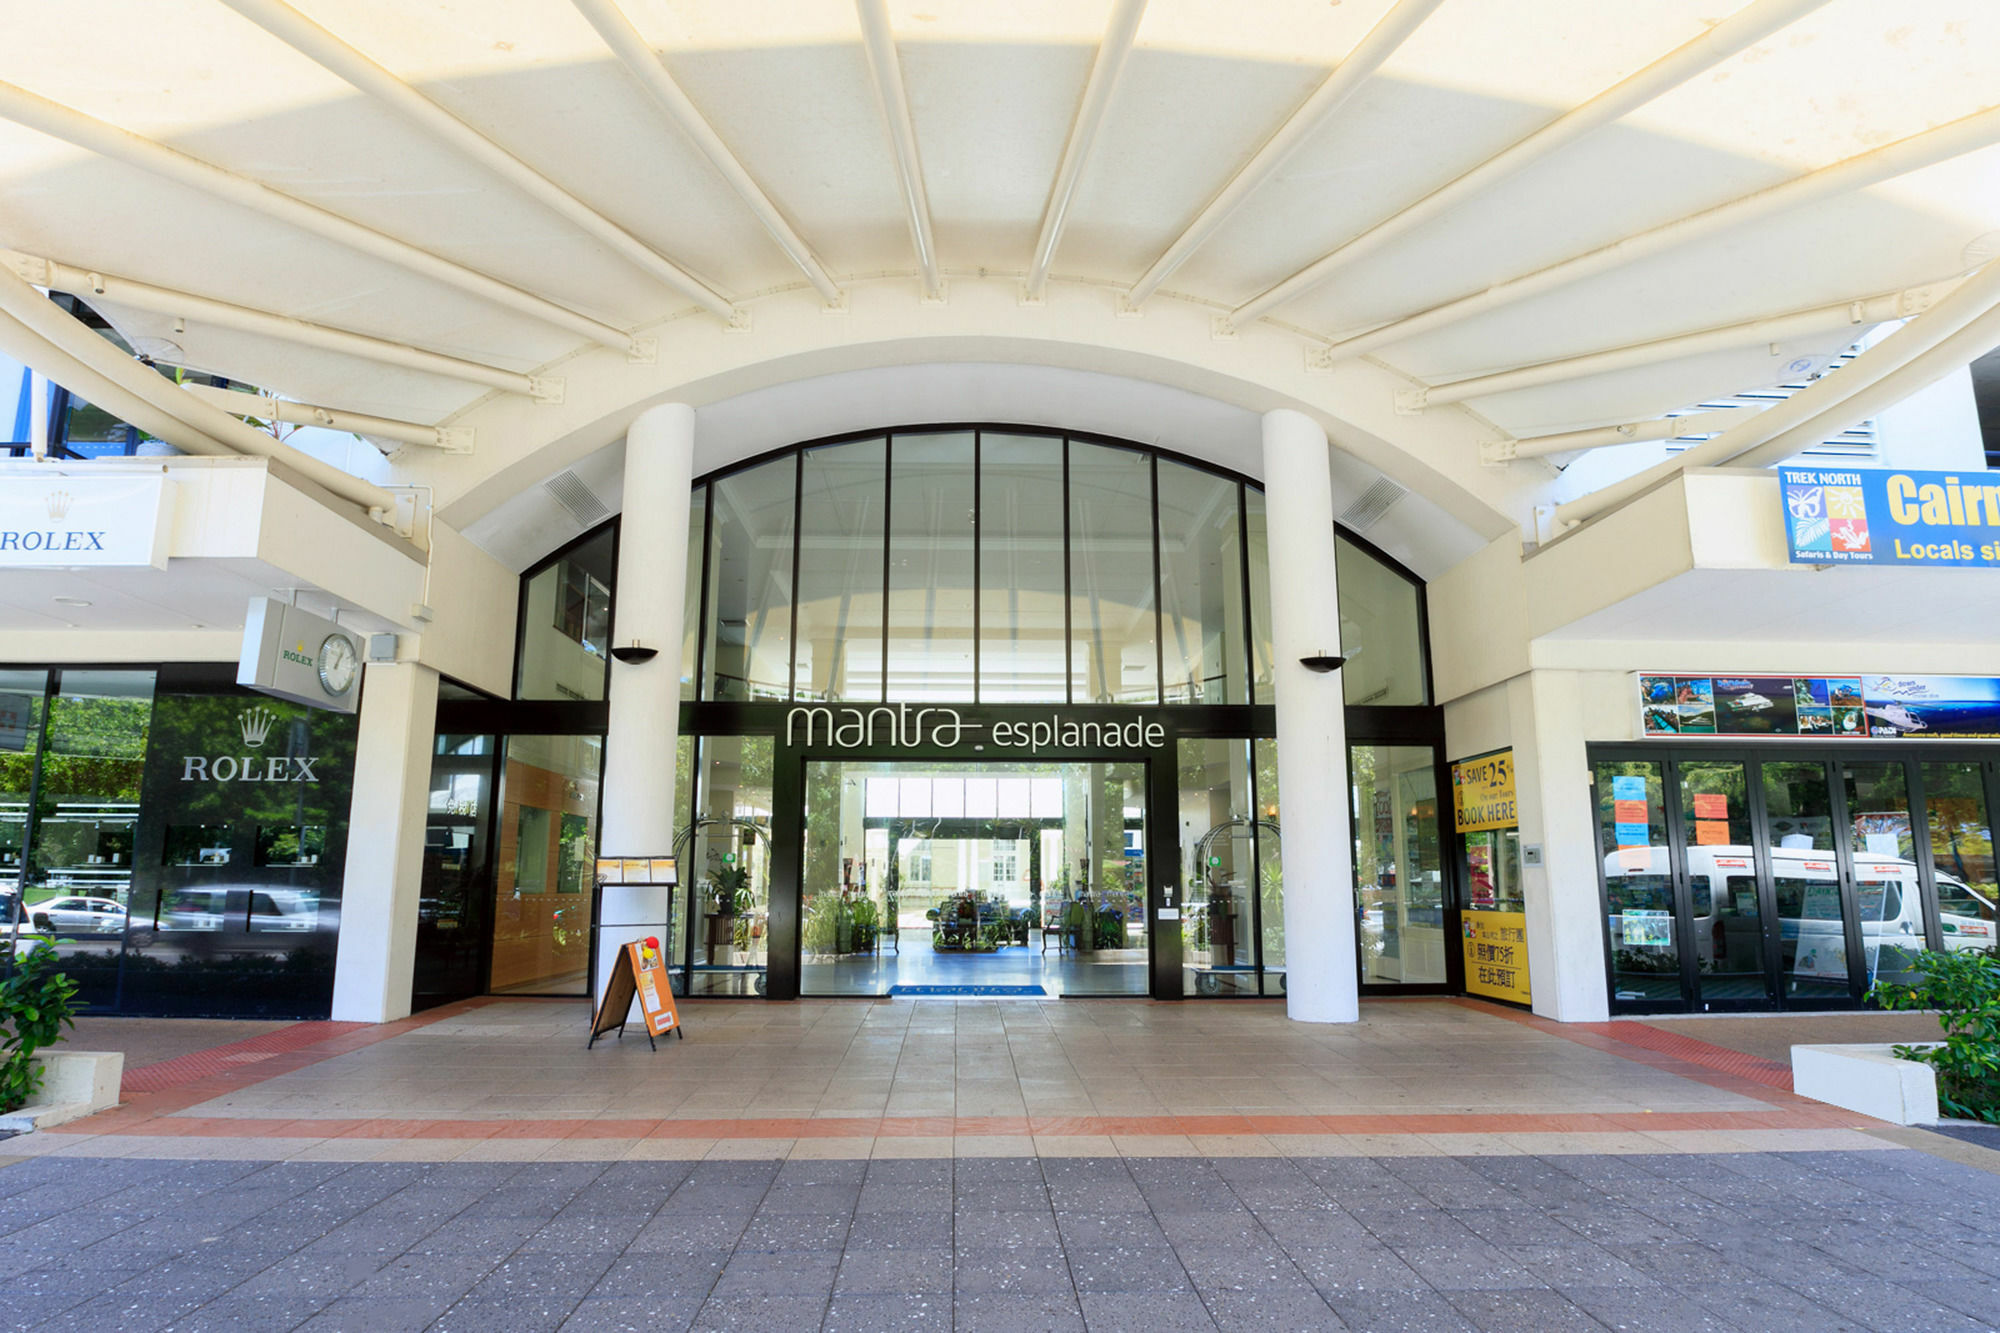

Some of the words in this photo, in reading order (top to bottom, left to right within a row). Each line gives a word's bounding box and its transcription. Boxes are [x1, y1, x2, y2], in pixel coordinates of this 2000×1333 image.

[1784, 472, 1818, 484] TREK
[1819, 473, 1862, 485] NORTH
[0, 531, 106, 551] ROLEX
[1894, 539, 1974, 560] Locals
[1795, 551, 1824, 559] Safaris
[1825, 551, 1832, 559] &
[1833, 552, 1848, 560] Day
[1850, 552, 1873, 560] Tours
[283, 650, 313, 667] ROLEX
[787, 702, 983, 748] mantra
[992, 714, 1165, 753] esplanade
[180, 756, 319, 782] ROLEX
[1466, 766, 1488, 785] SAVE
[1457, 806, 1486, 826] BOOK
[1487, 801, 1516, 823] HERE
